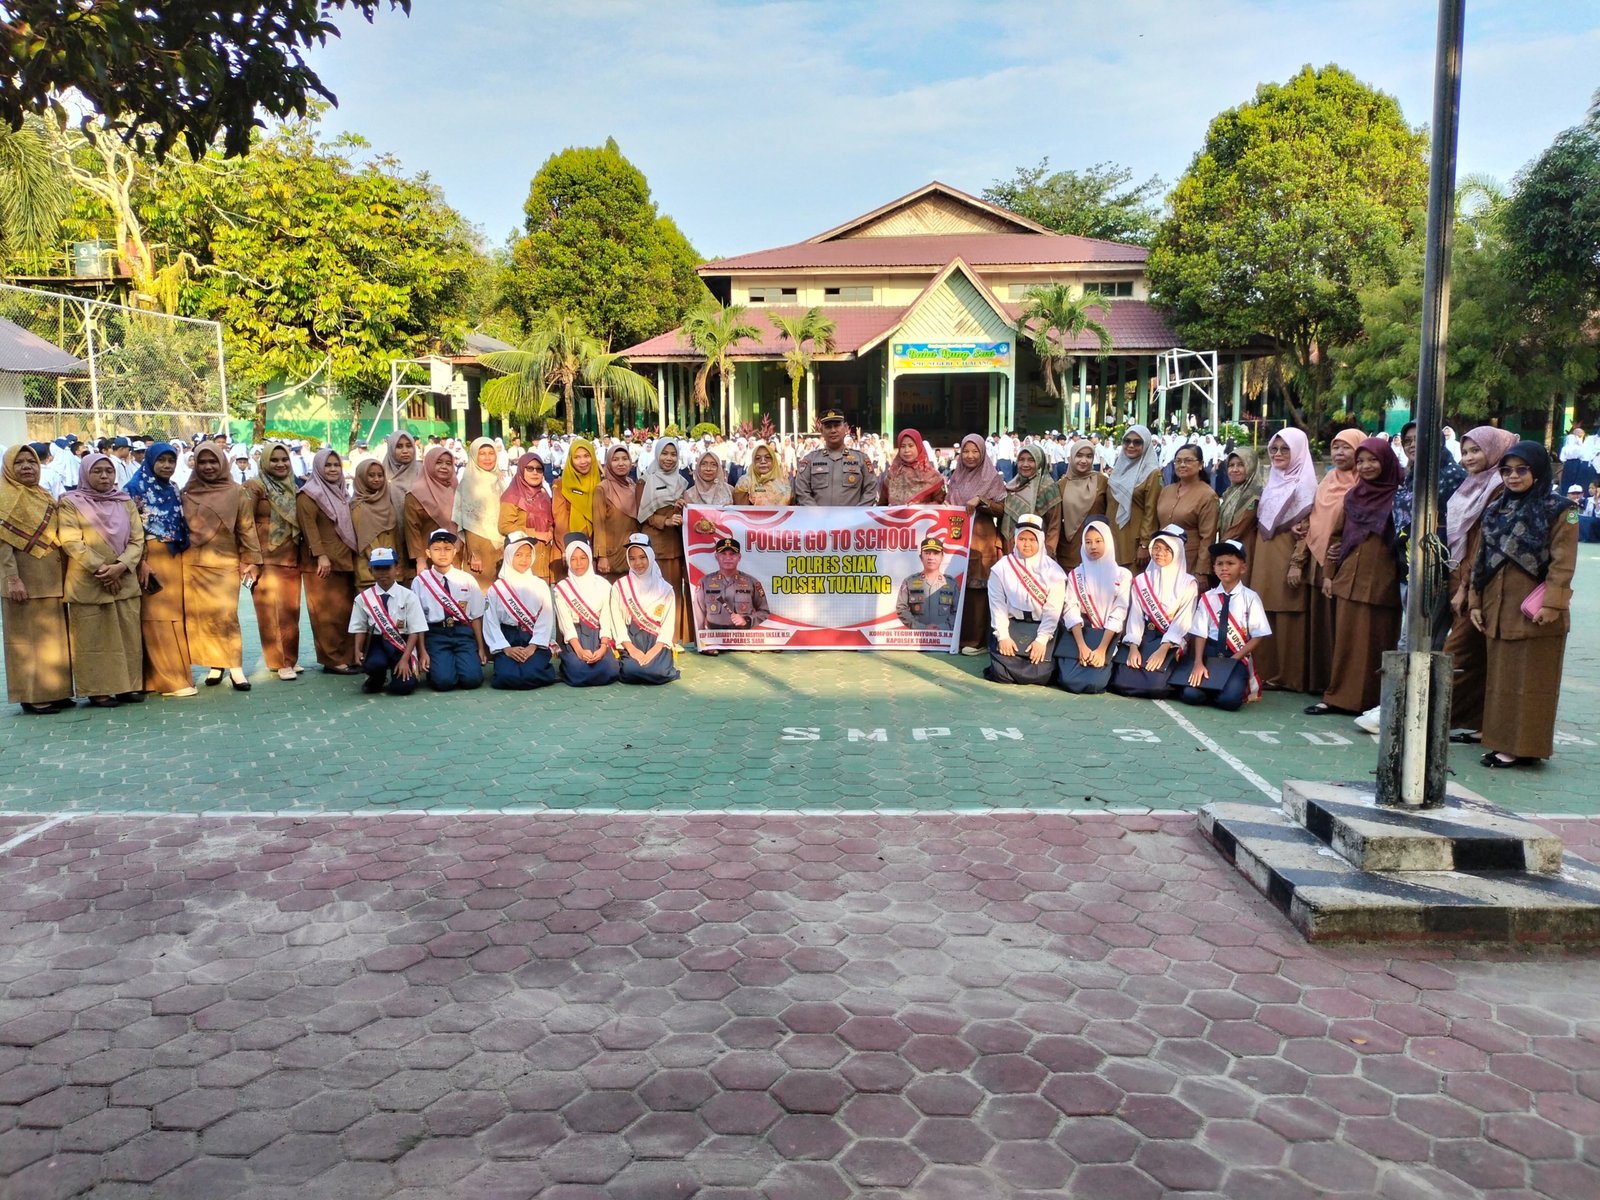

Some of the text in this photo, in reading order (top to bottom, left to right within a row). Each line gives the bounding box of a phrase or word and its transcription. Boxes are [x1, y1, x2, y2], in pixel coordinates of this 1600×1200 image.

[745, 527, 918, 552] POLICE GO TO SCHOOL
[787, 555, 877, 574] POLRES SIAK
[772, 576, 826, 594] POLSEK
[827, 576, 891, 594] TUALANG
[1023, 575, 1040, 595] PETUGAS
[508, 598, 525, 622] PETUGAS
[572, 598, 590, 621] PETUGAS
[628, 597, 642, 618] PETUGAS
[1141, 588, 1157, 613] PETUGAS
[373, 605, 387, 629] PETUGAS
[1112, 728, 1162, 743] 3
